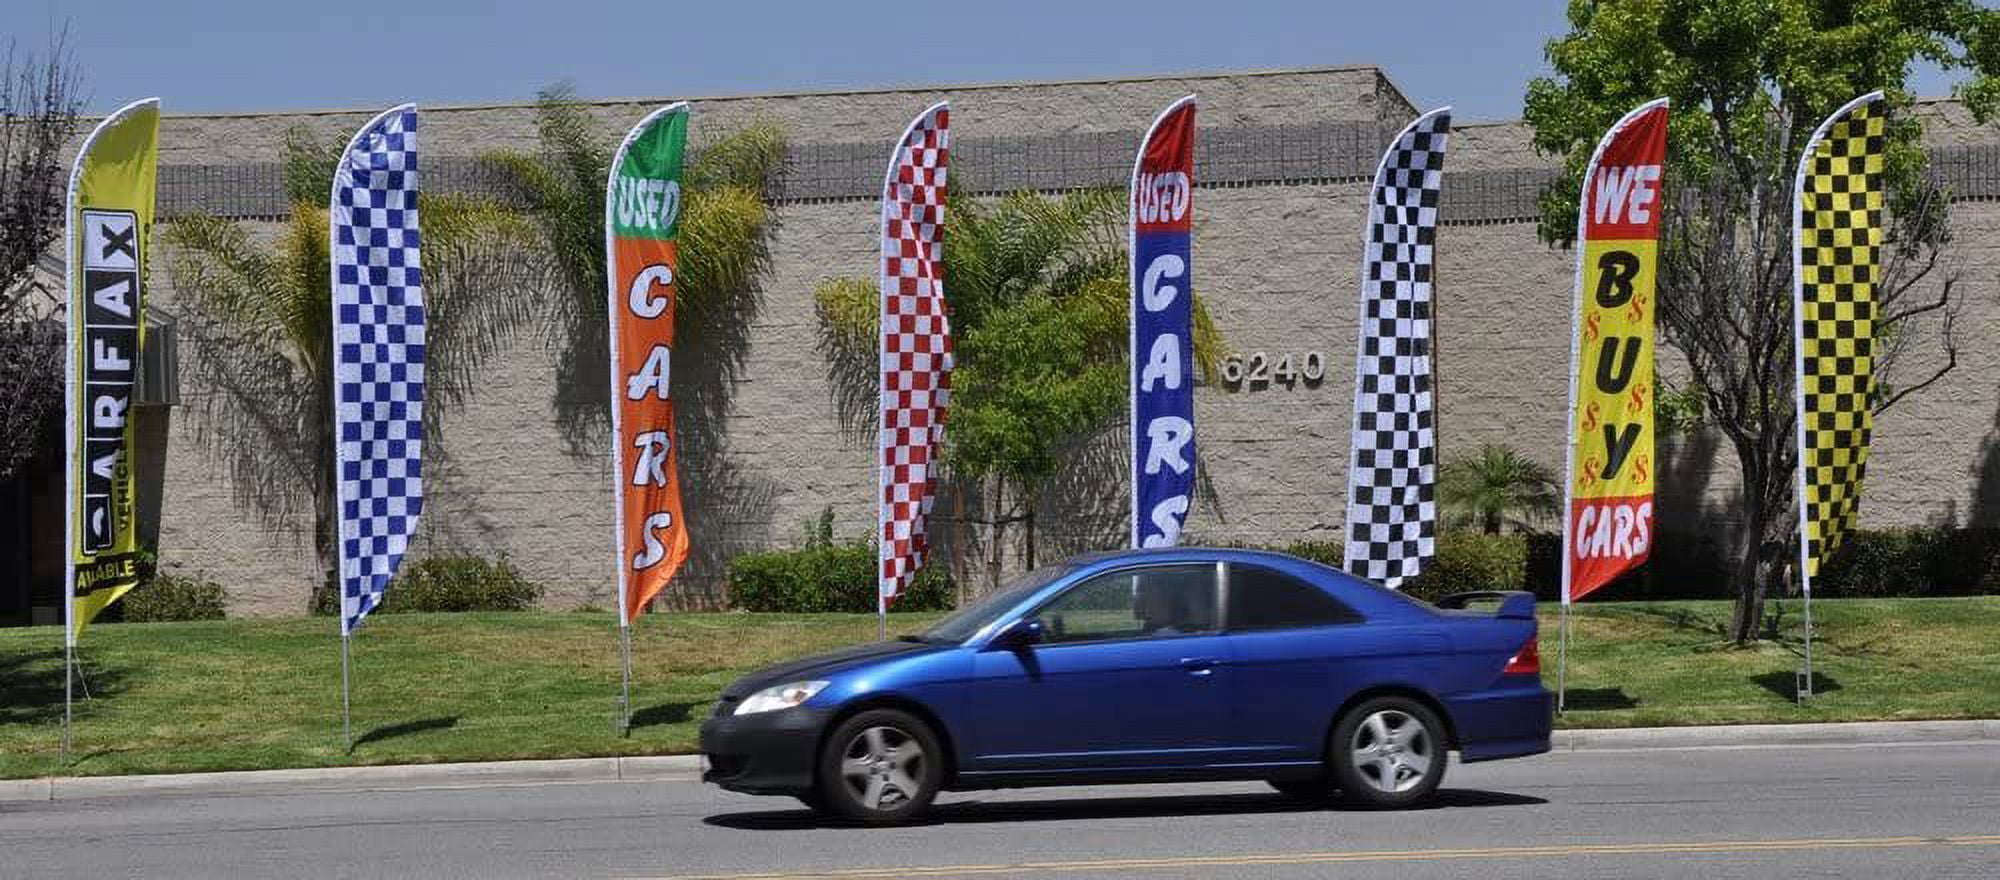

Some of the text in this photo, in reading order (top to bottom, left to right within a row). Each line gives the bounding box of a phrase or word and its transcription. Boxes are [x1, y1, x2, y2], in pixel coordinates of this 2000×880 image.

[616, 174, 681, 231] USED
[1139, 171, 1190, 224] USED
[1595, 165, 1661, 225] WE
[1221, 351, 1325, 380] 6240
[1595, 250, 1643, 480] BUY
[627, 263, 674, 570] CARS
[1140, 253, 1193, 548] CARS
[1576, 502, 1652, 560] CARS
